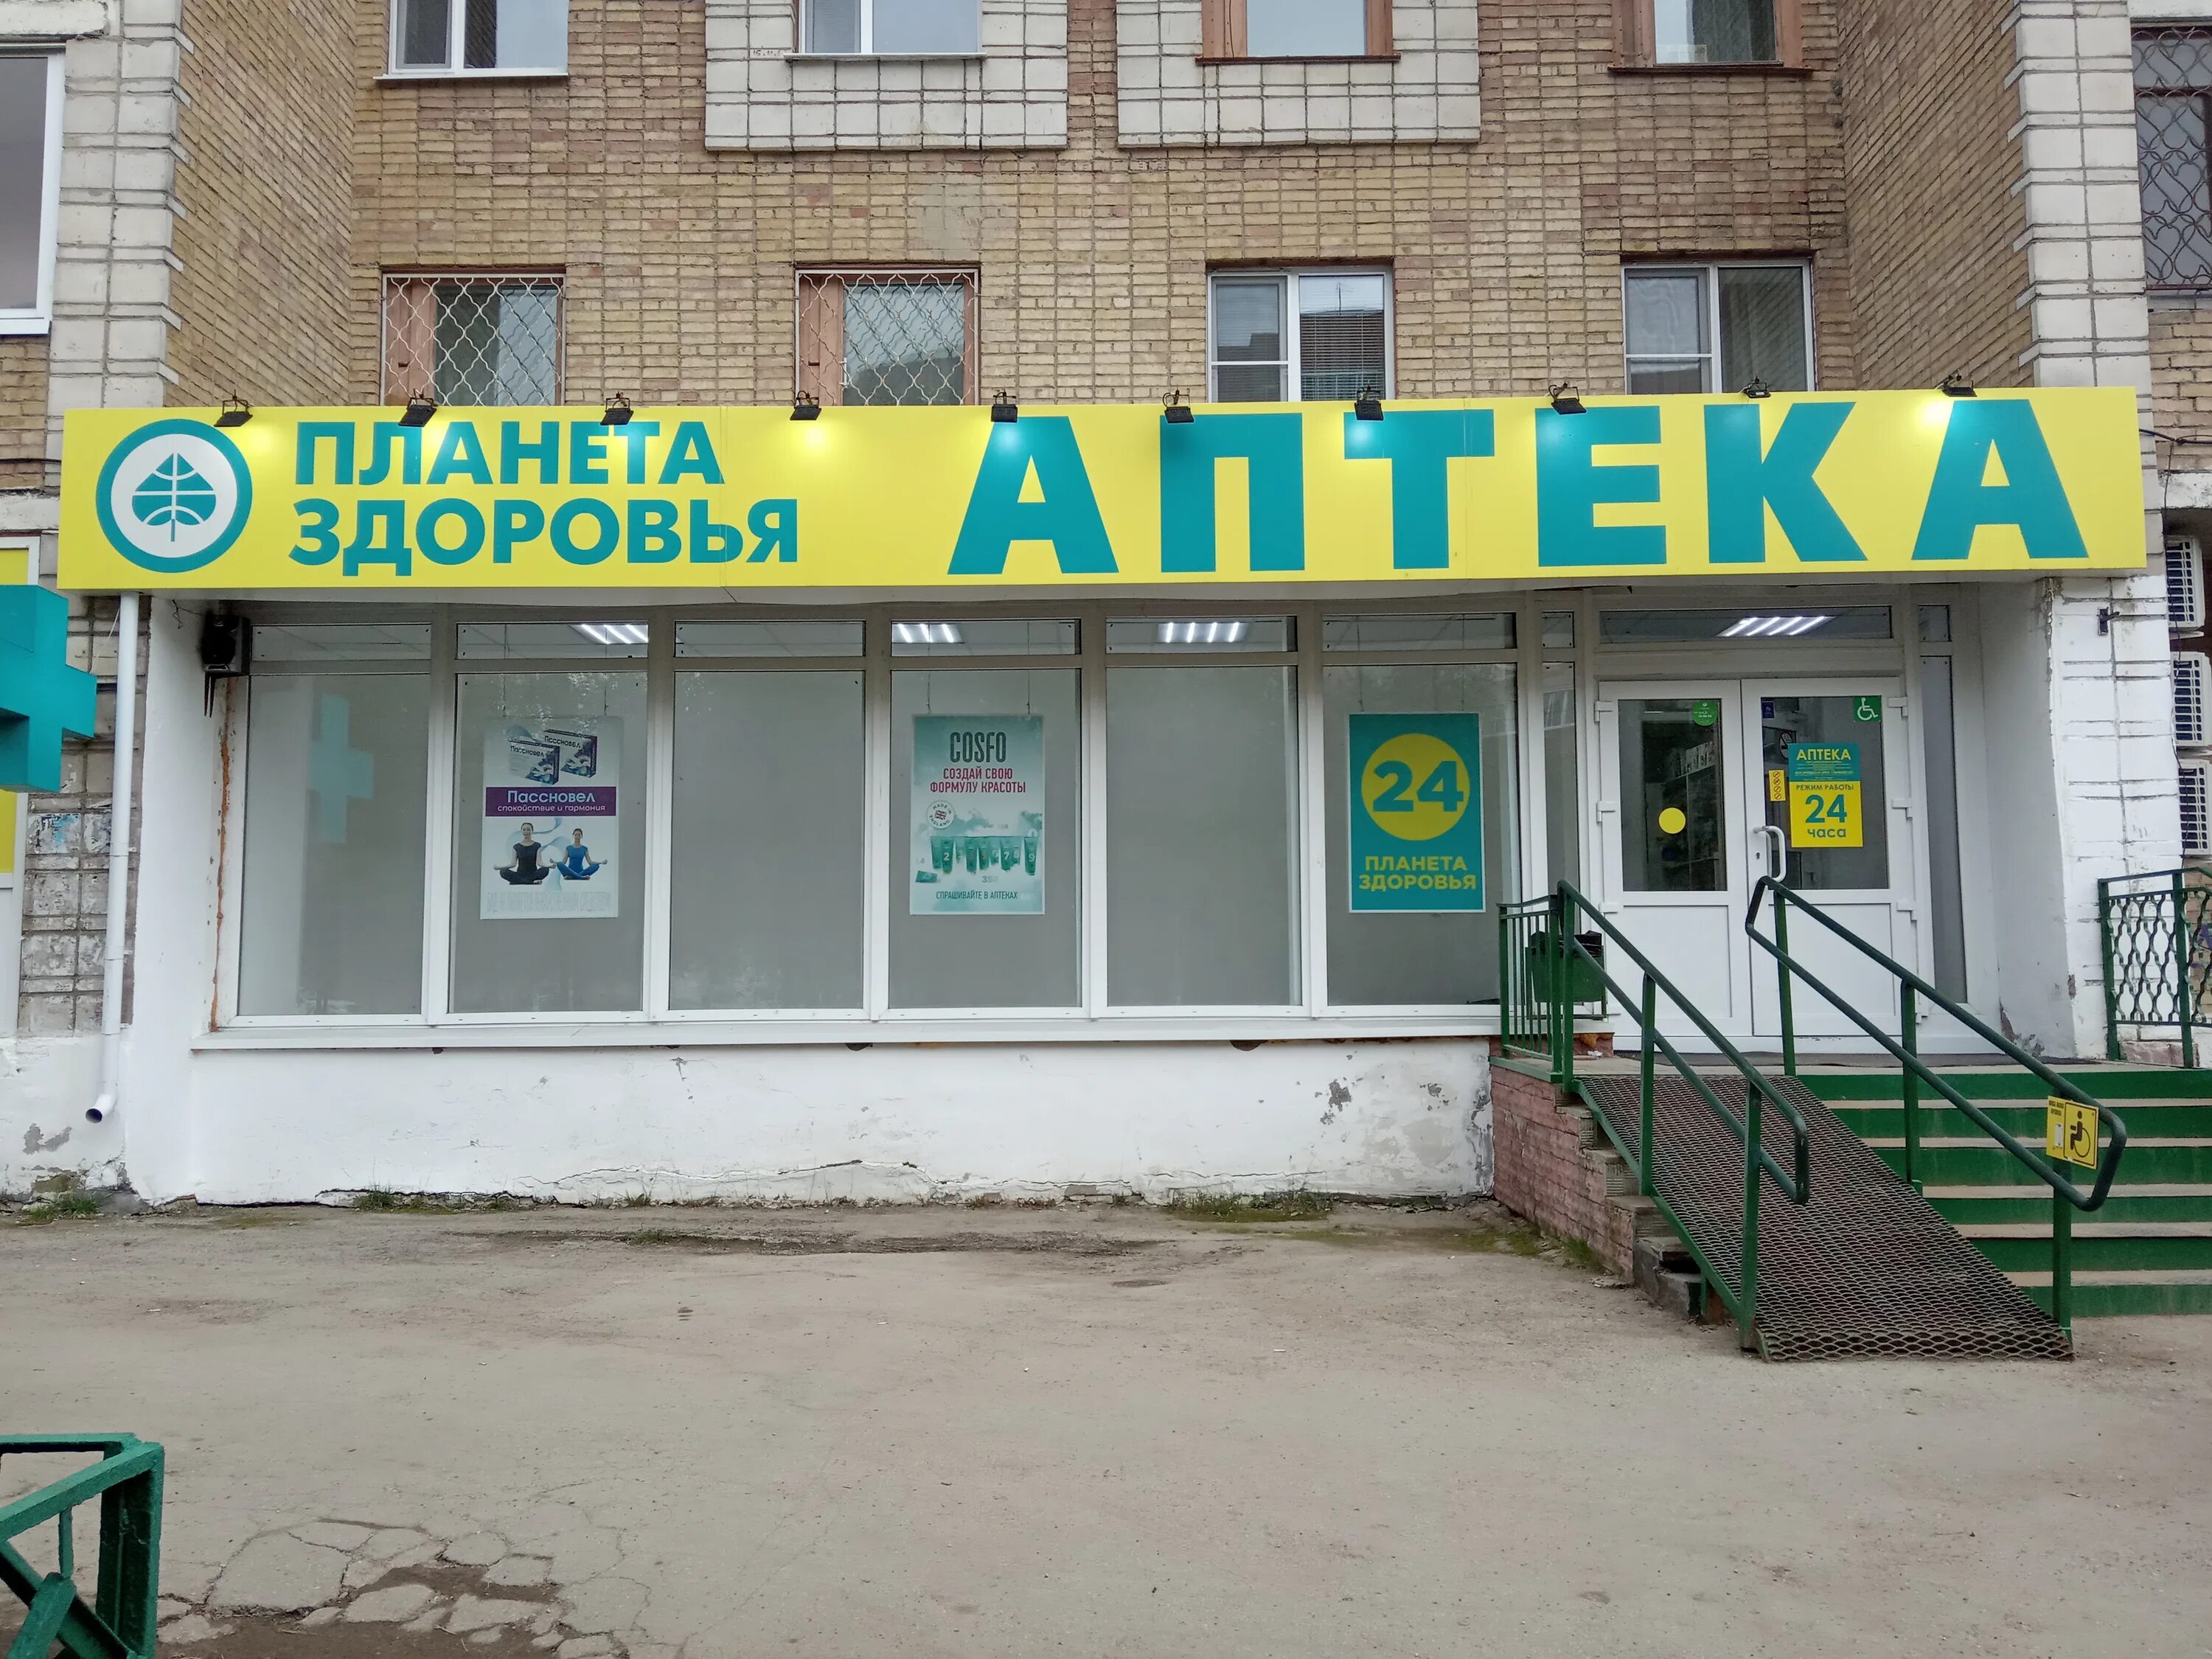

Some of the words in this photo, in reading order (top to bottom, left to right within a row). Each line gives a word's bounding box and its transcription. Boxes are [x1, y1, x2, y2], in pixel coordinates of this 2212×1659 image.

[296, 421, 723, 484] ПЛАНЕТА
[949, 399, 2088, 574] АПТЕКА
[291, 498, 798, 577] ЗДОРОВЬЯ
[950, 731, 1006, 763] COSFO
[1796, 748, 1851, 761] АПТЕКА
[943, 766, 982, 781] СОЗДАЙ
[986, 768, 1013, 779] СВОЮ
[930, 782, 978, 793] ФОРМУЛУ
[981, 782, 1026, 793] КРАСОТЫ
[1373, 760, 1464, 812] 24
[507, 790, 596, 803] Пассновел
[1805, 794, 1847, 824] 24
[1807, 828, 1846, 838] часа
[1366, 856, 1468, 871] ПЛАНЕТА
[1359, 874, 1477, 892] ЗДОРОВЬЯ
[936, 890, 982, 900] СПРАШИВАЙТЕ
[984, 891, 988, 900] В
[990, 891, 1018, 900] АПТЕКАХ
